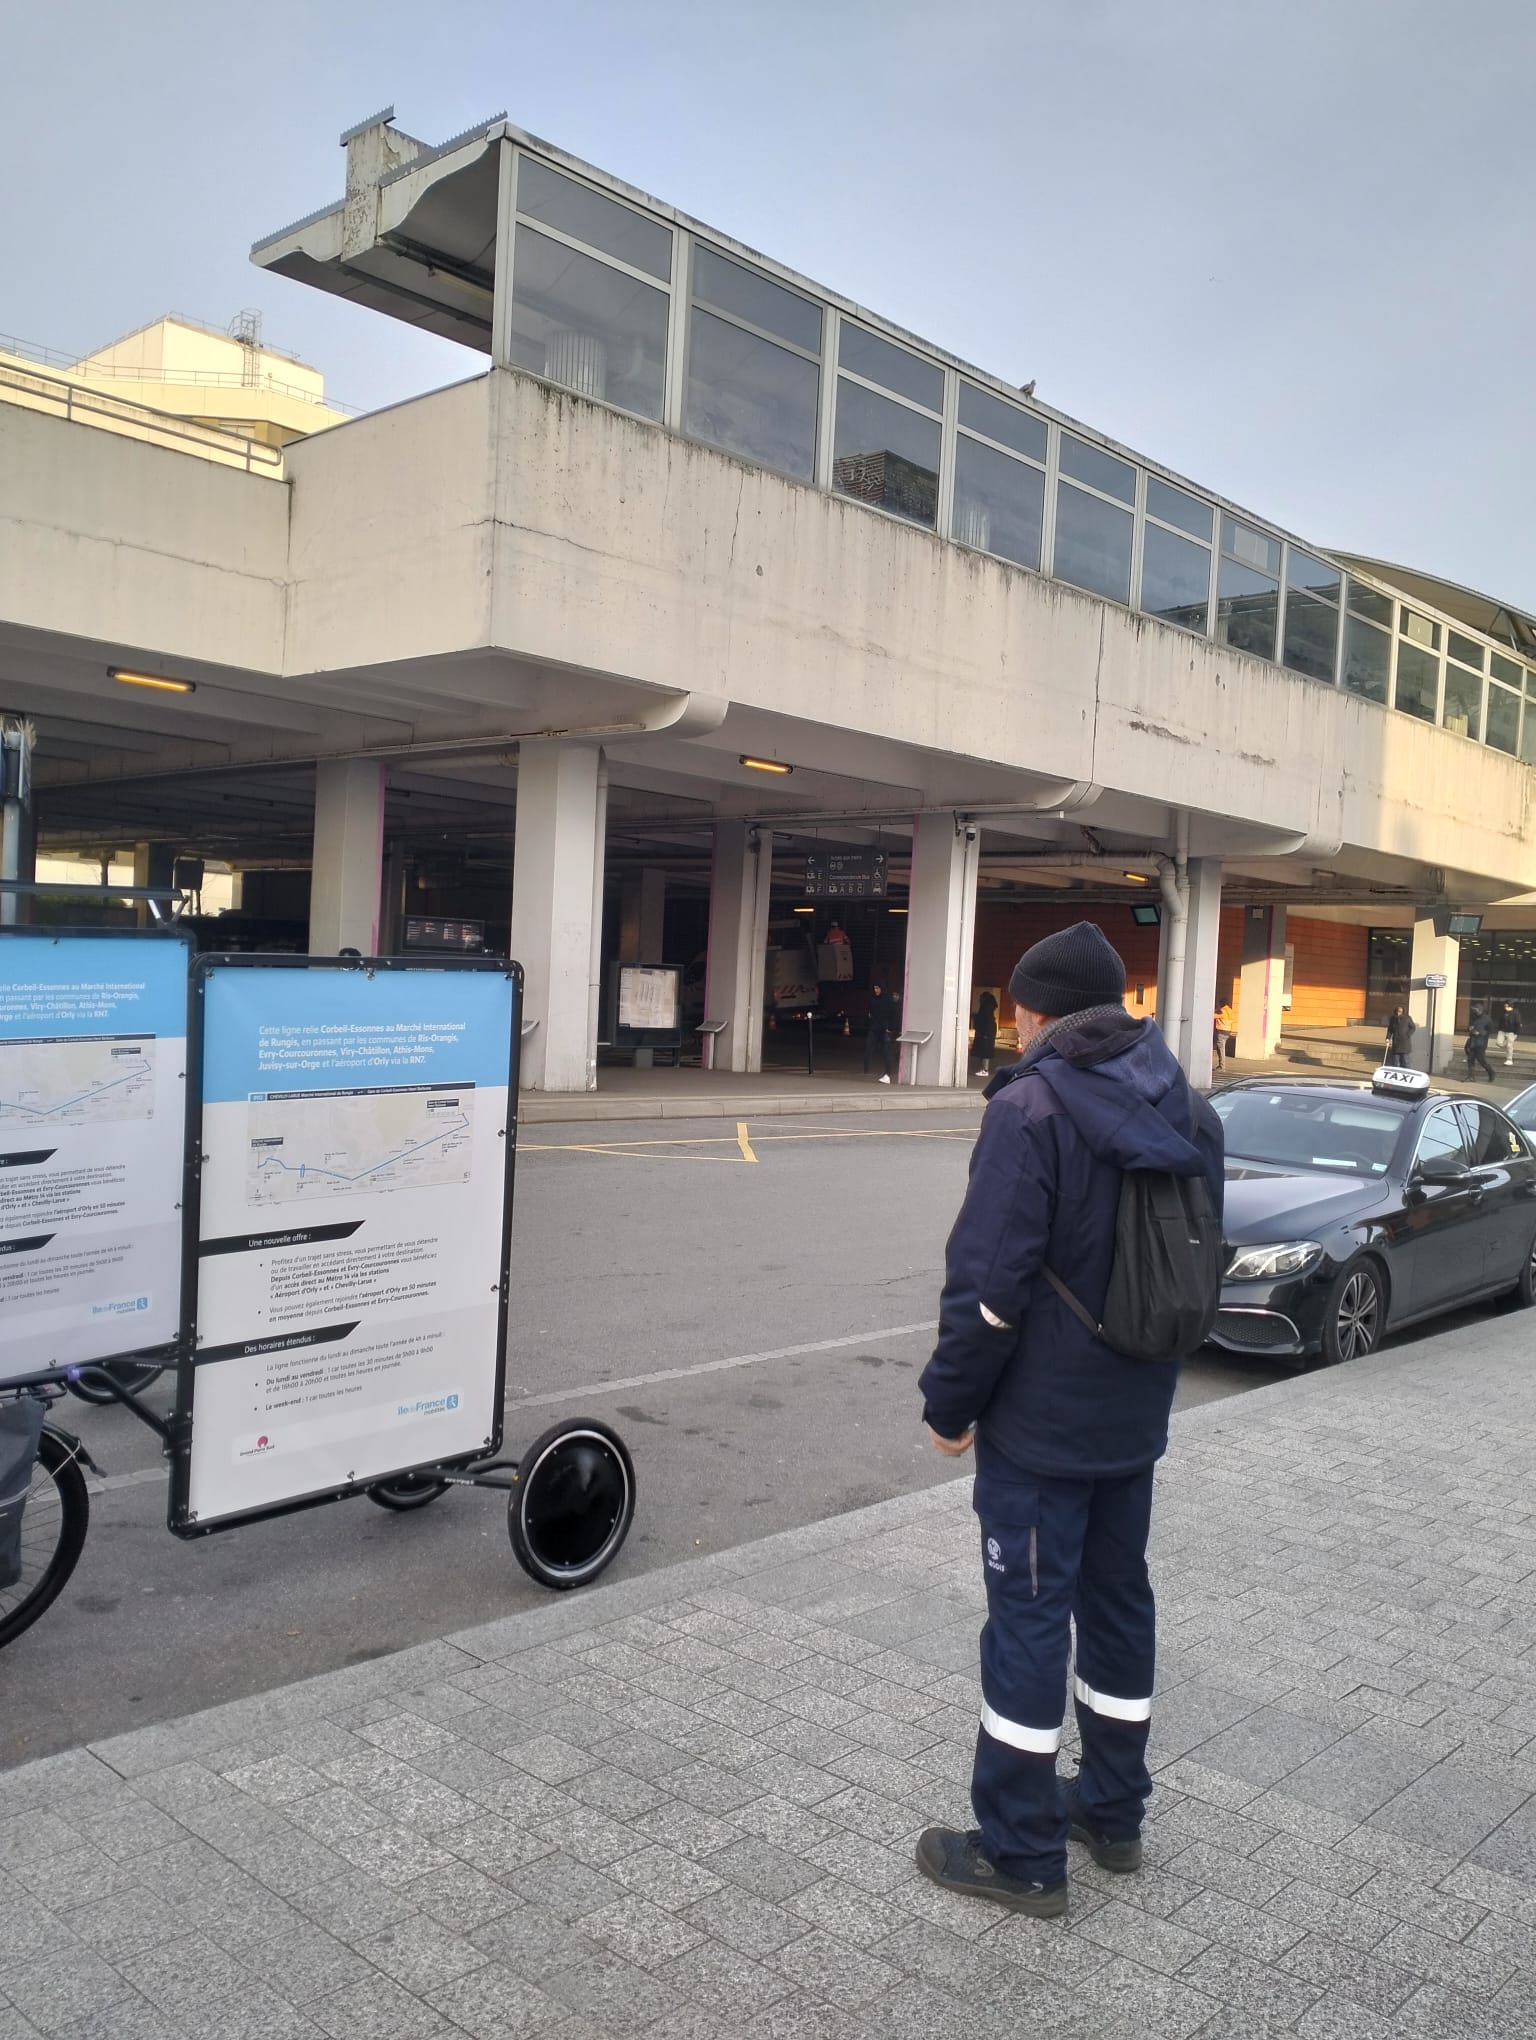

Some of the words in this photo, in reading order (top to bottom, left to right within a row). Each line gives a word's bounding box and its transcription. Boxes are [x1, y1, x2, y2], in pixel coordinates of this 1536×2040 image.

[1383, 1072, 1414, 1084] TAXI
[264, 1236, 291, 1245] nouvelle
[258, 1342, 285, 1351] horaires
[286, 1336, 312, 1346] étendus
[416, 1400, 445, 1411] France
